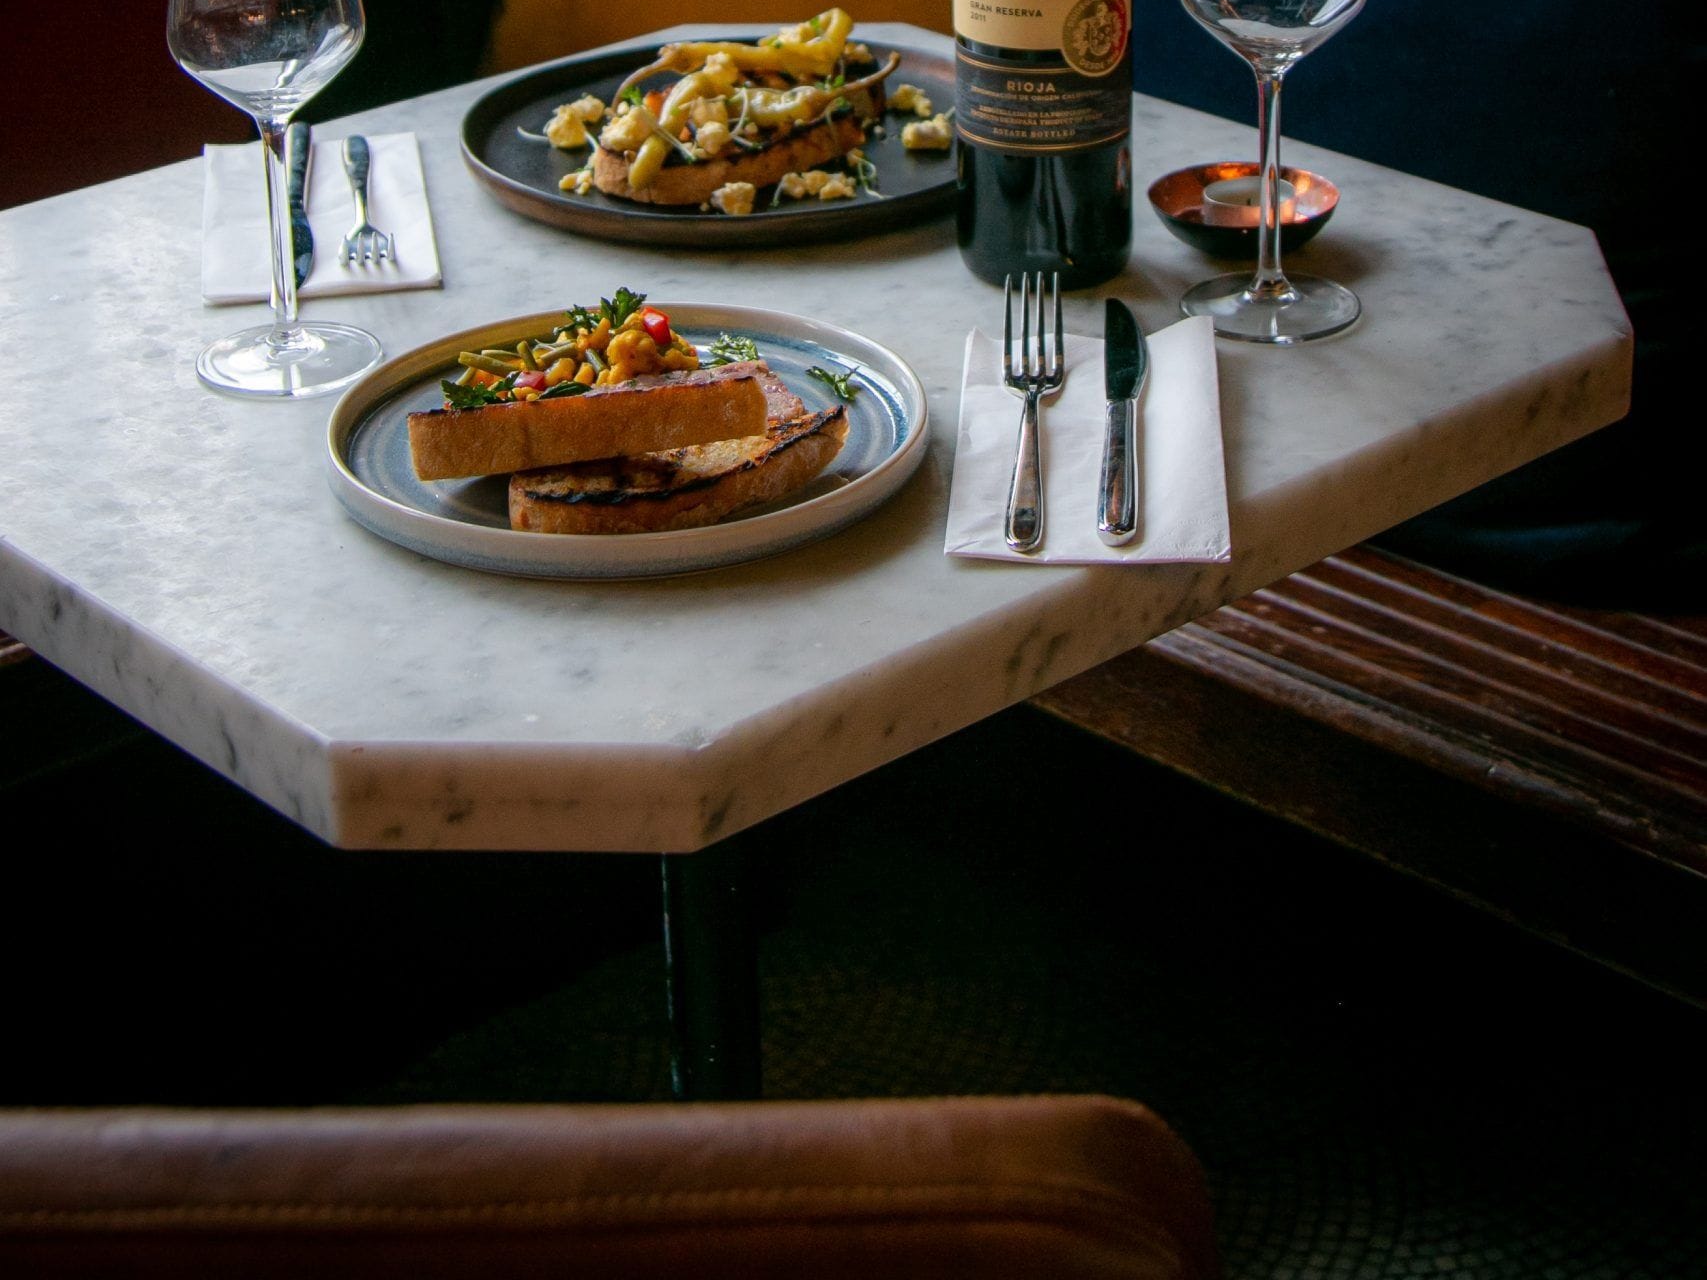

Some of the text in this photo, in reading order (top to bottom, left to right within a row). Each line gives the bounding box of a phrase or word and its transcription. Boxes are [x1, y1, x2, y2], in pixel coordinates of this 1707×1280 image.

[970, 0, 1043, 18] GRAN RESERVA
[1007, 80, 1056, 93] RIOJA
[1030, 128, 1076, 138] BOTTLED
